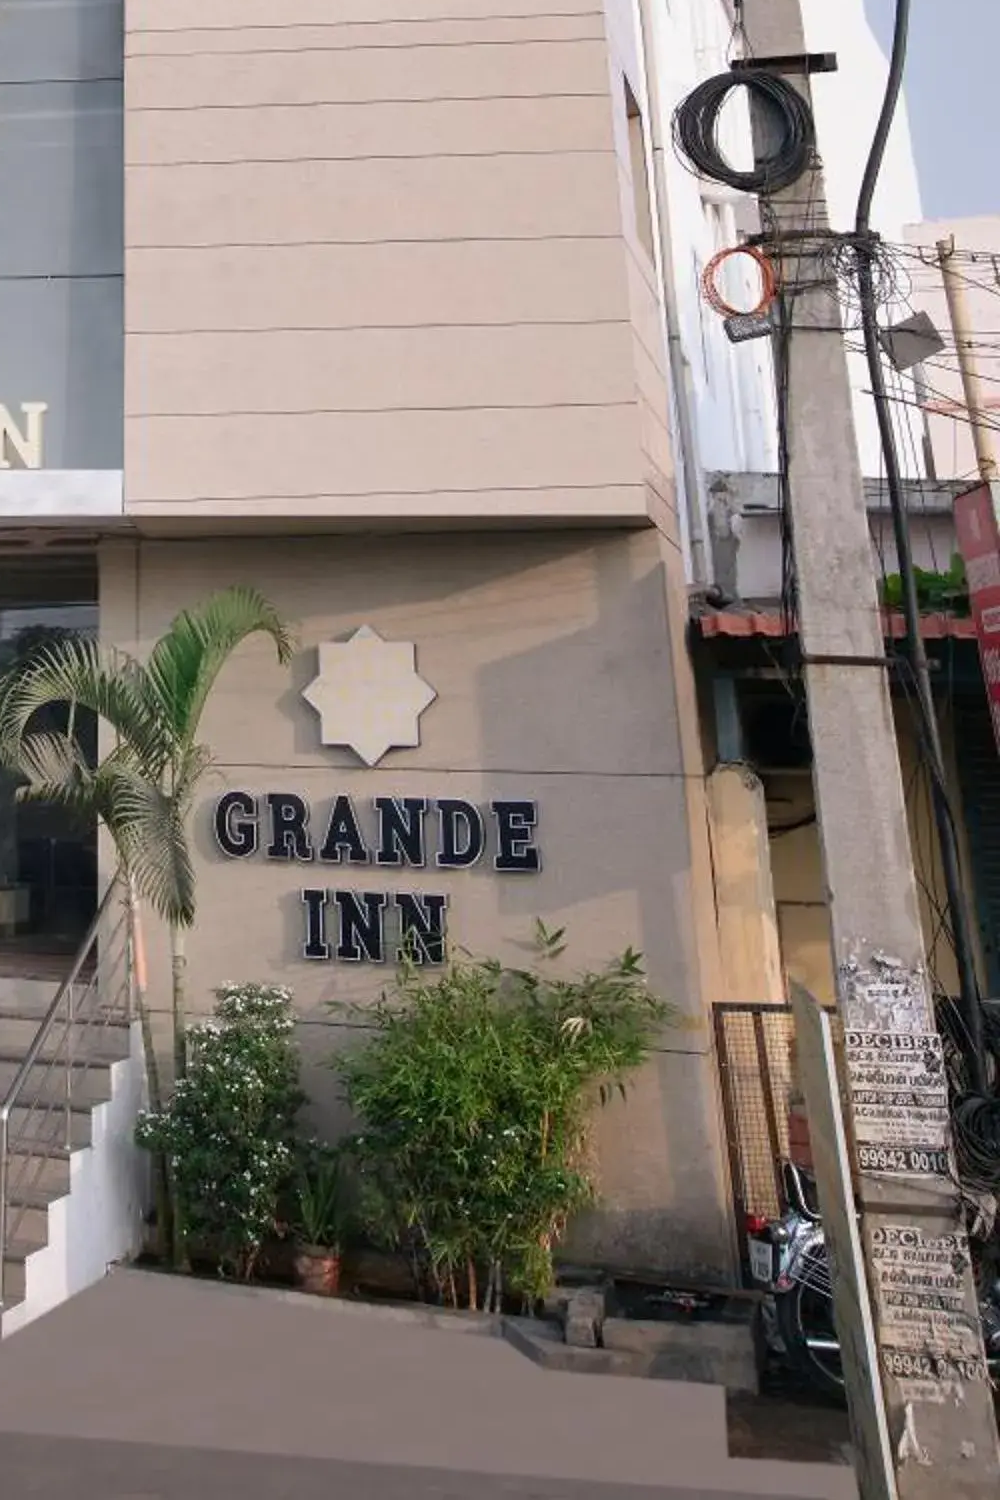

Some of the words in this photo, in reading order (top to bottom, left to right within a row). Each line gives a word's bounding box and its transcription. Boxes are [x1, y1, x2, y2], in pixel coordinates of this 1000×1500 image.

[213, 789, 542, 872] GRANDE
[301, 887, 450, 965] INN
[846, 1032, 941, 1052] DECIBEL
[860, 1147, 907, 1170] 99942
